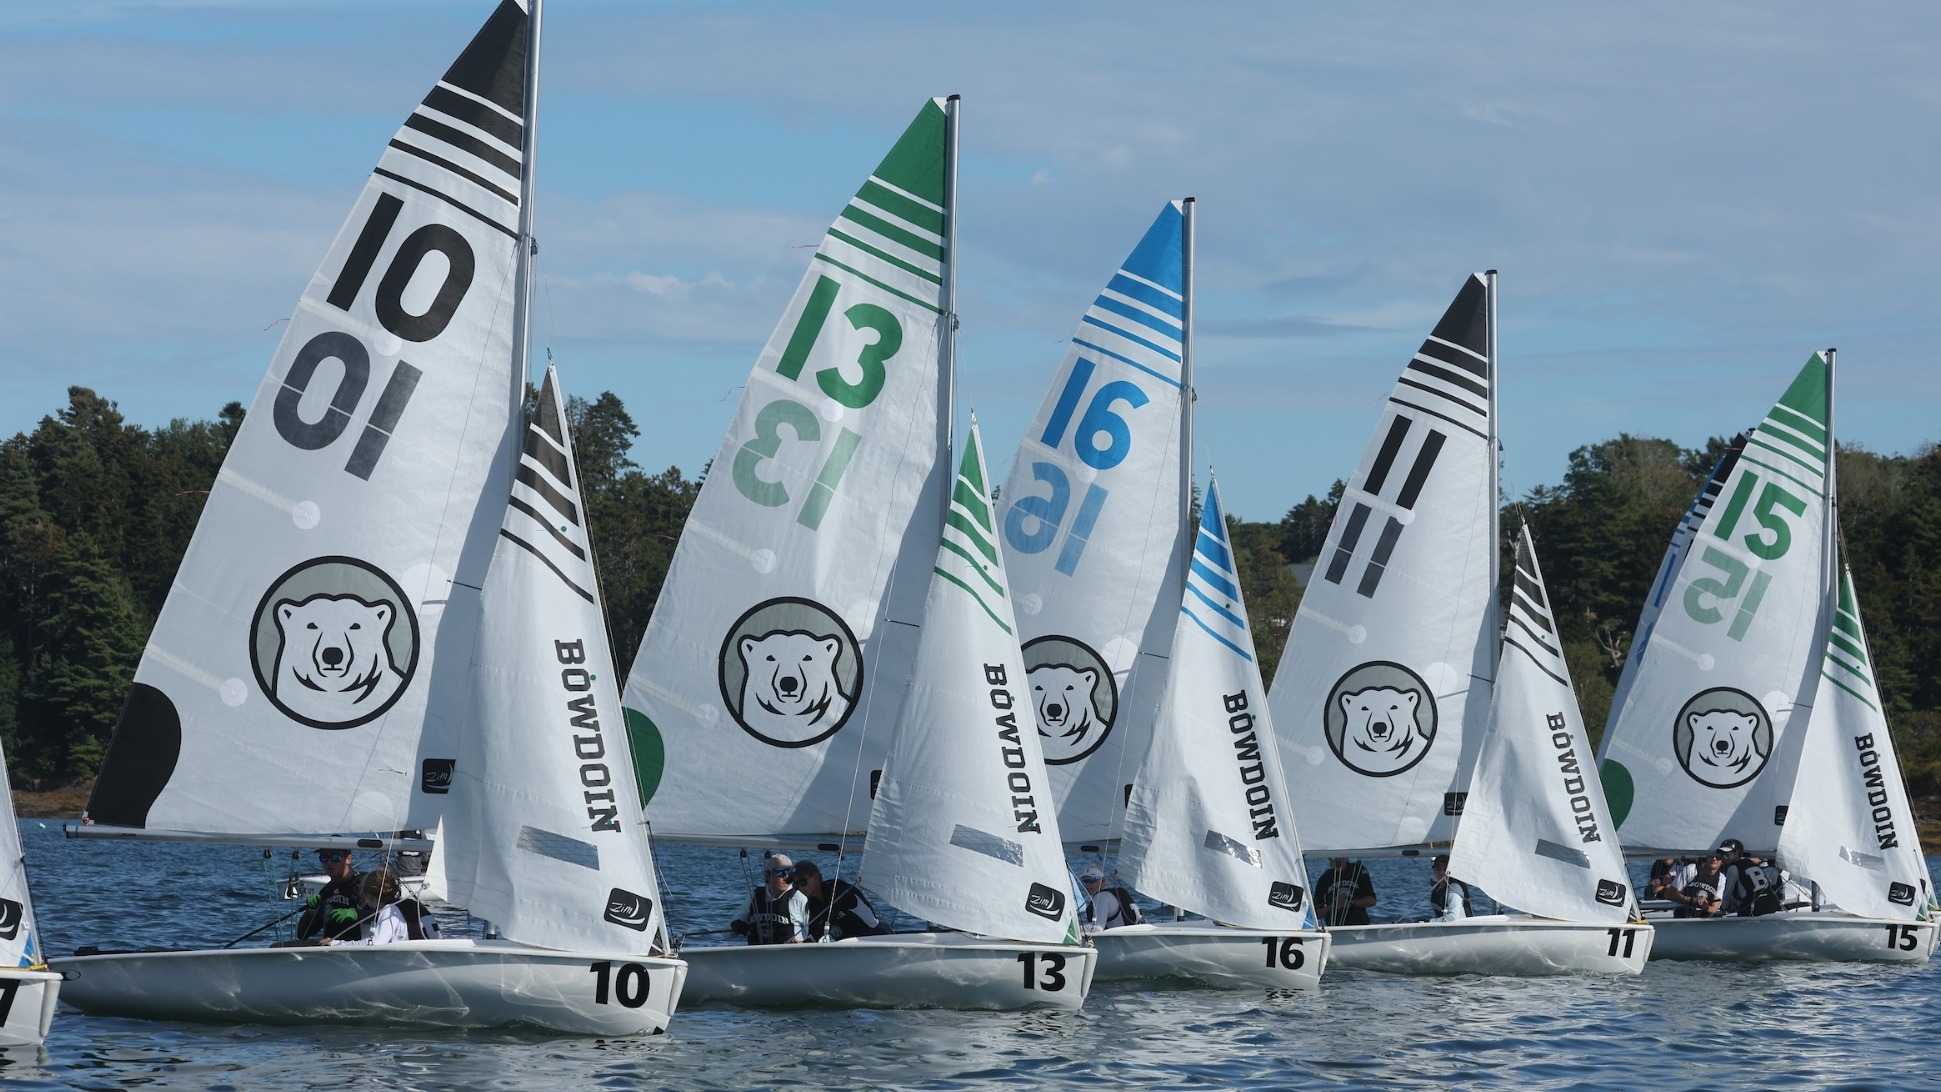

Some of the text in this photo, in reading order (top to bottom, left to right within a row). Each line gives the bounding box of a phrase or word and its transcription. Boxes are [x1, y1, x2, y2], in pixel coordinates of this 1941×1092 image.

[326, 191, 475, 342] 10
[775, 273, 904, 409] 13
[1040, 356, 1151, 470] 16
[1363, 413, 1447, 511] 11
[1713, 469, 1808, 561] 15
[554, 638, 622, 834] BOWDOIN
[983, 662, 1043, 835] BOWDOIN
[1222, 688, 1280, 841] BOWDOIN
[1546, 711, 1602, 844] BOWDOIN
[1854, 732, 1899, 851] BOWDOIN
[1745, 866, 1770, 892] B
[589, 961, 650, 1009] 10
[1017, 951, 1067, 992] 13
[1261, 936, 1305, 971] 16
[1606, 928, 1636, 959] 11
[1885, 923, 1919, 952] 15
